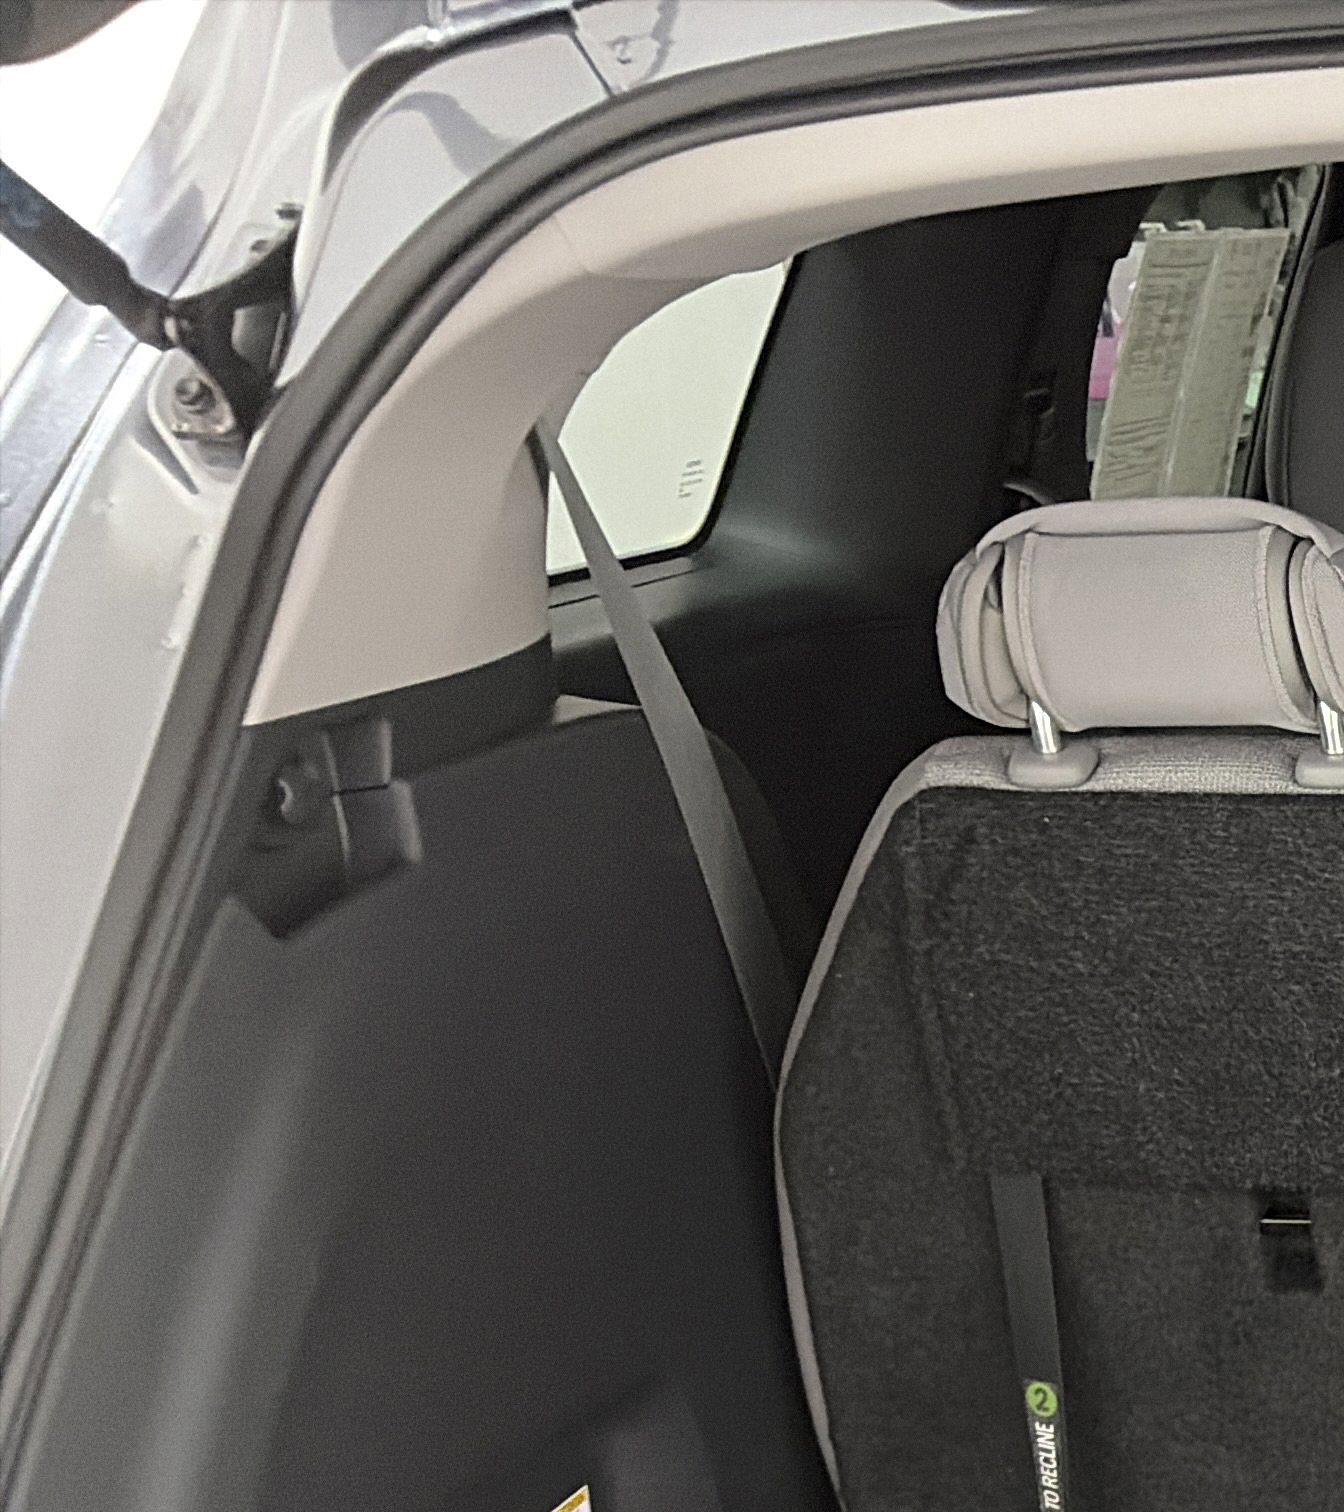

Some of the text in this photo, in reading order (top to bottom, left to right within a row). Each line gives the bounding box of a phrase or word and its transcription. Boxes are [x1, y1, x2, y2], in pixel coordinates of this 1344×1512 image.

[1034, 1387, 1049, 1412] 2
[1035, 1421, 1061, 1510] TO RECLINE
